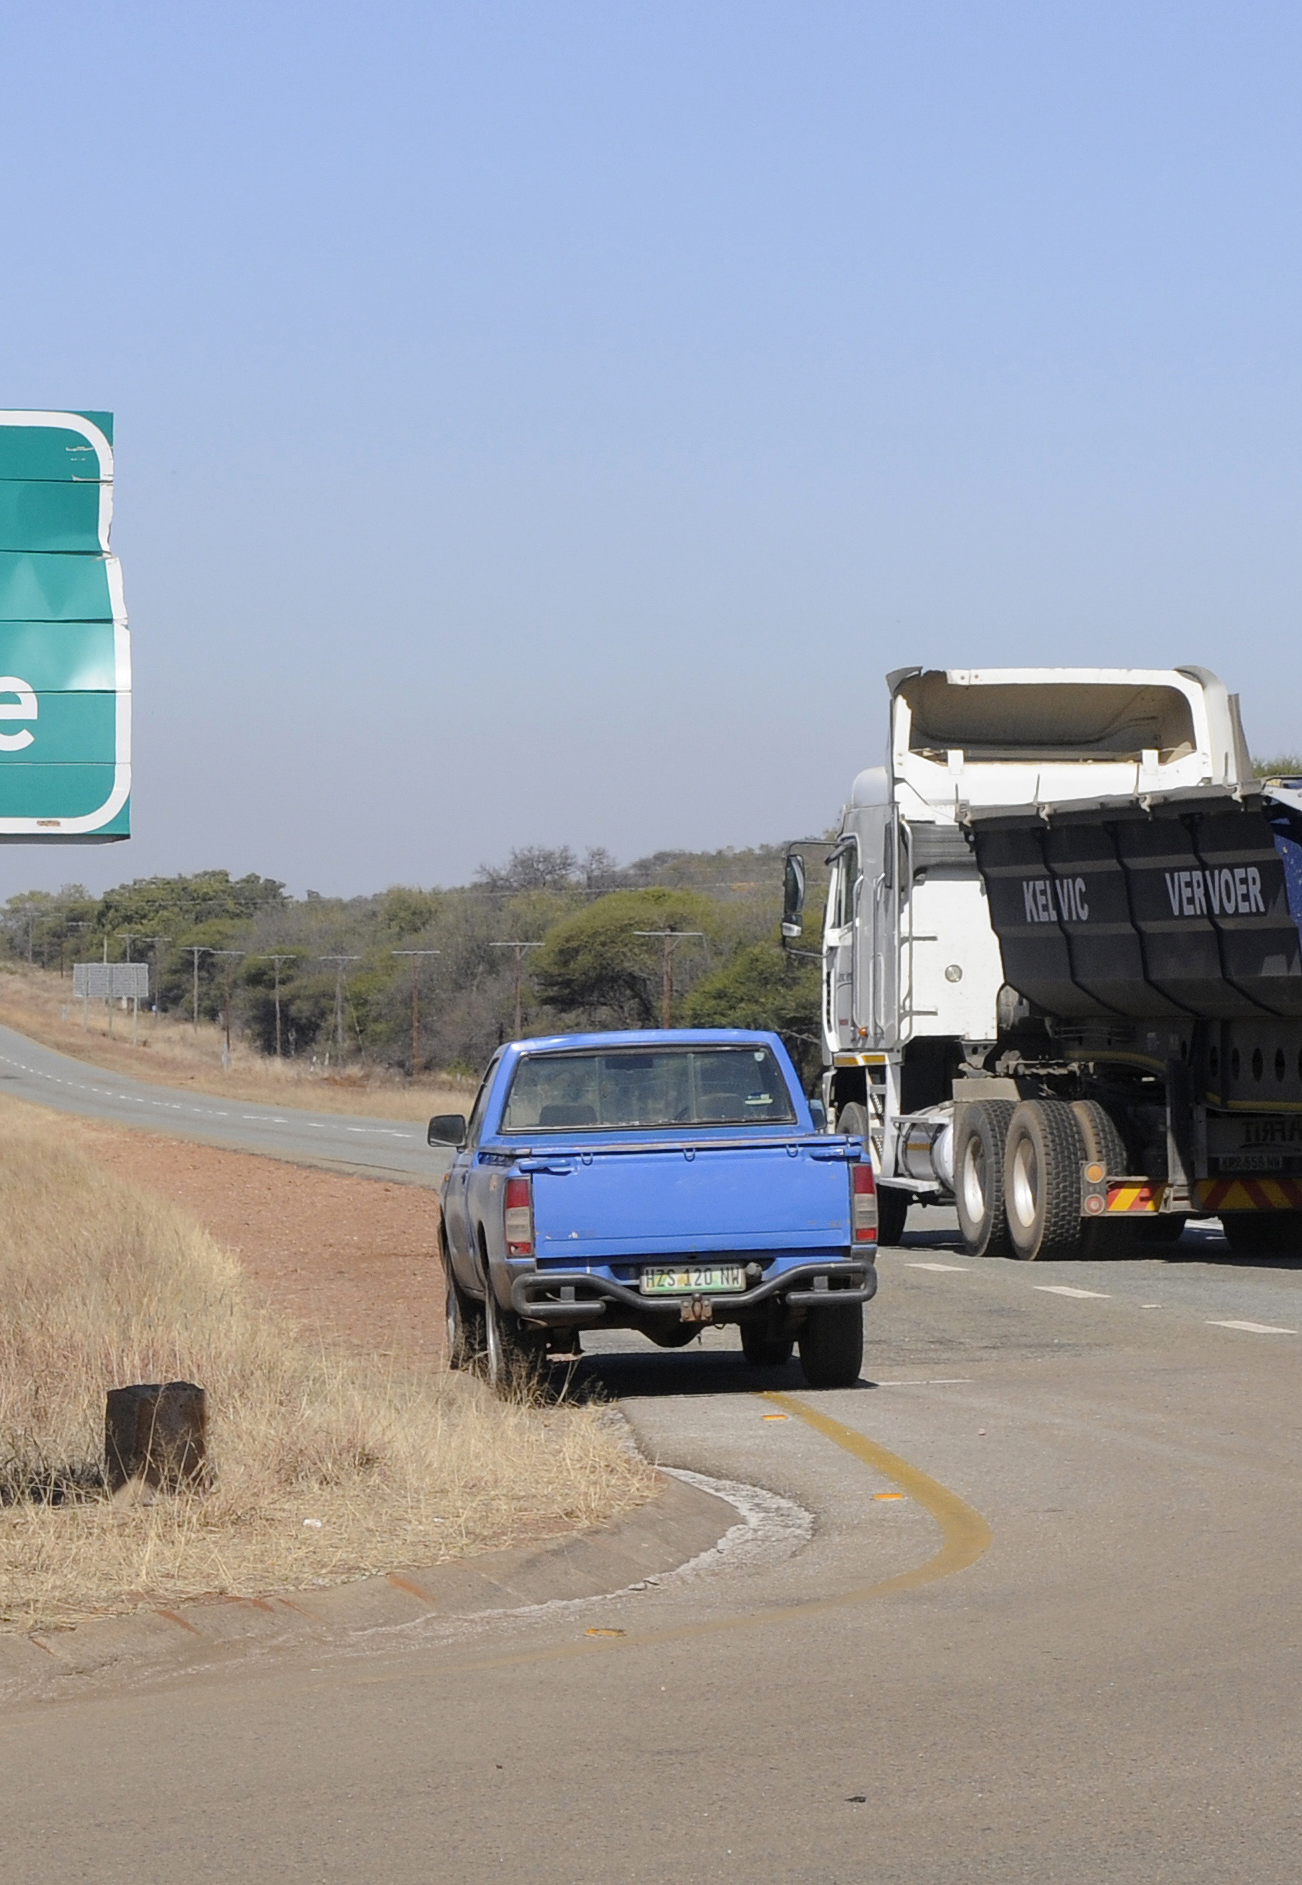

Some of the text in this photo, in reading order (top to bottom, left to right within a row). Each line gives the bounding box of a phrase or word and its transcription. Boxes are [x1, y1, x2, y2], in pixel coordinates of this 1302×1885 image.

[1022, 867, 1266, 922] KELVIC VERVOER
[646, 1266, 740, 1288] HZS 120 NW
